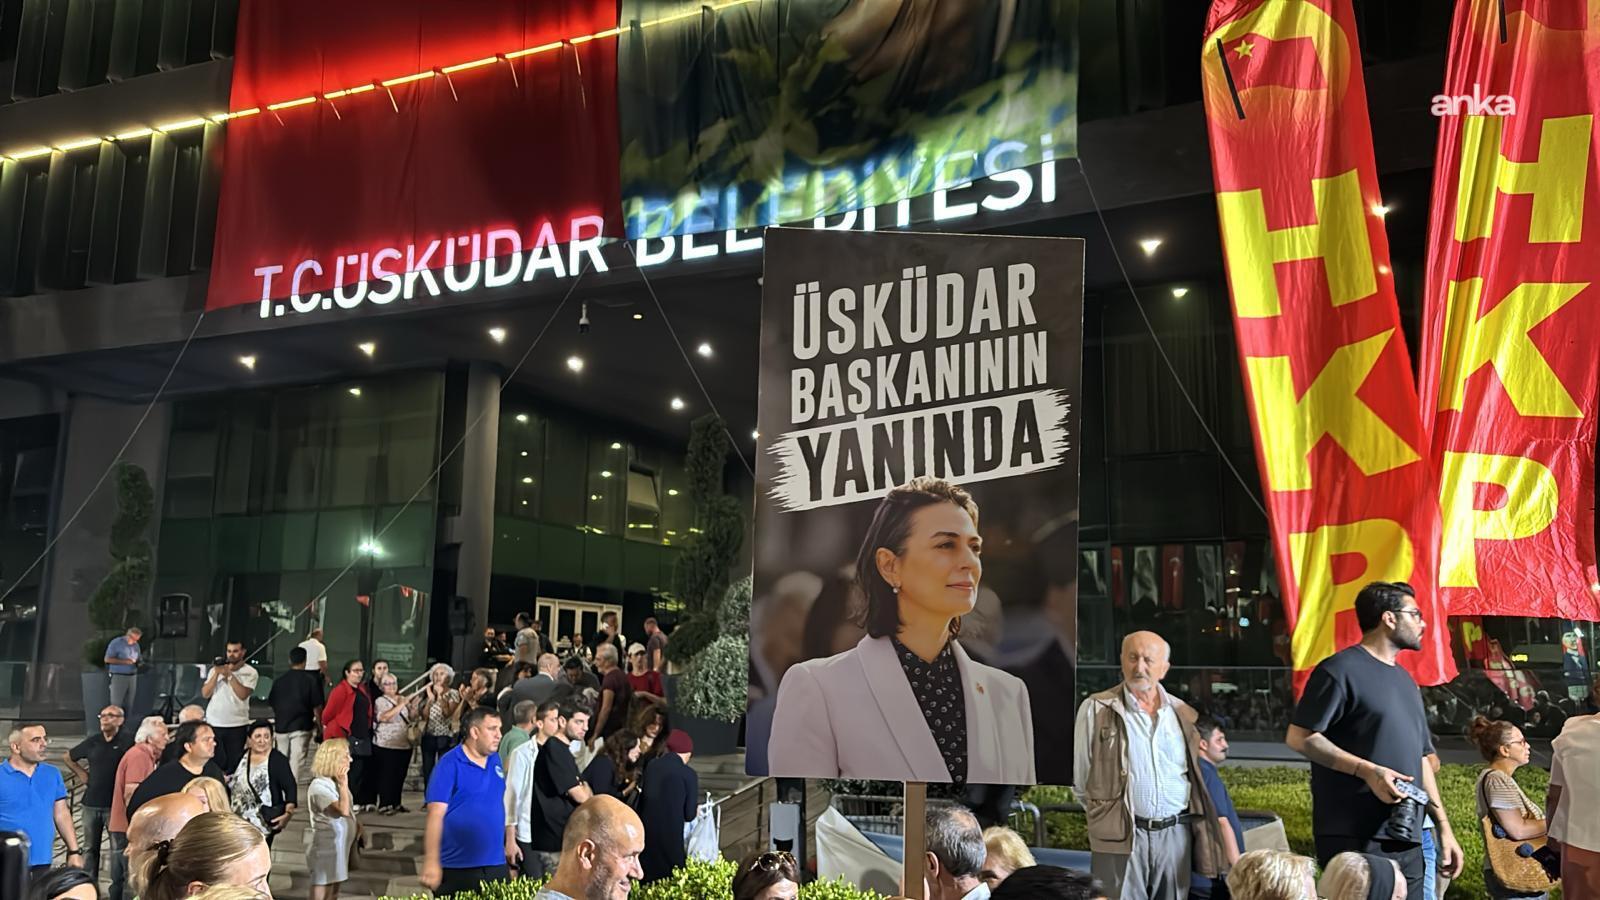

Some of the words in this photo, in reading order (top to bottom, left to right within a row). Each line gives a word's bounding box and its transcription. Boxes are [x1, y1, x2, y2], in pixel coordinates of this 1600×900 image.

[793, 262, 1037, 360] ÜSKÜDAR
[1438, 114, 1593, 588] HKP
[791, 330, 1047, 424] BAŞKANININ
[1217, 168, 1422, 672] HKP
[796, 398, 1045, 502] YANINDA
